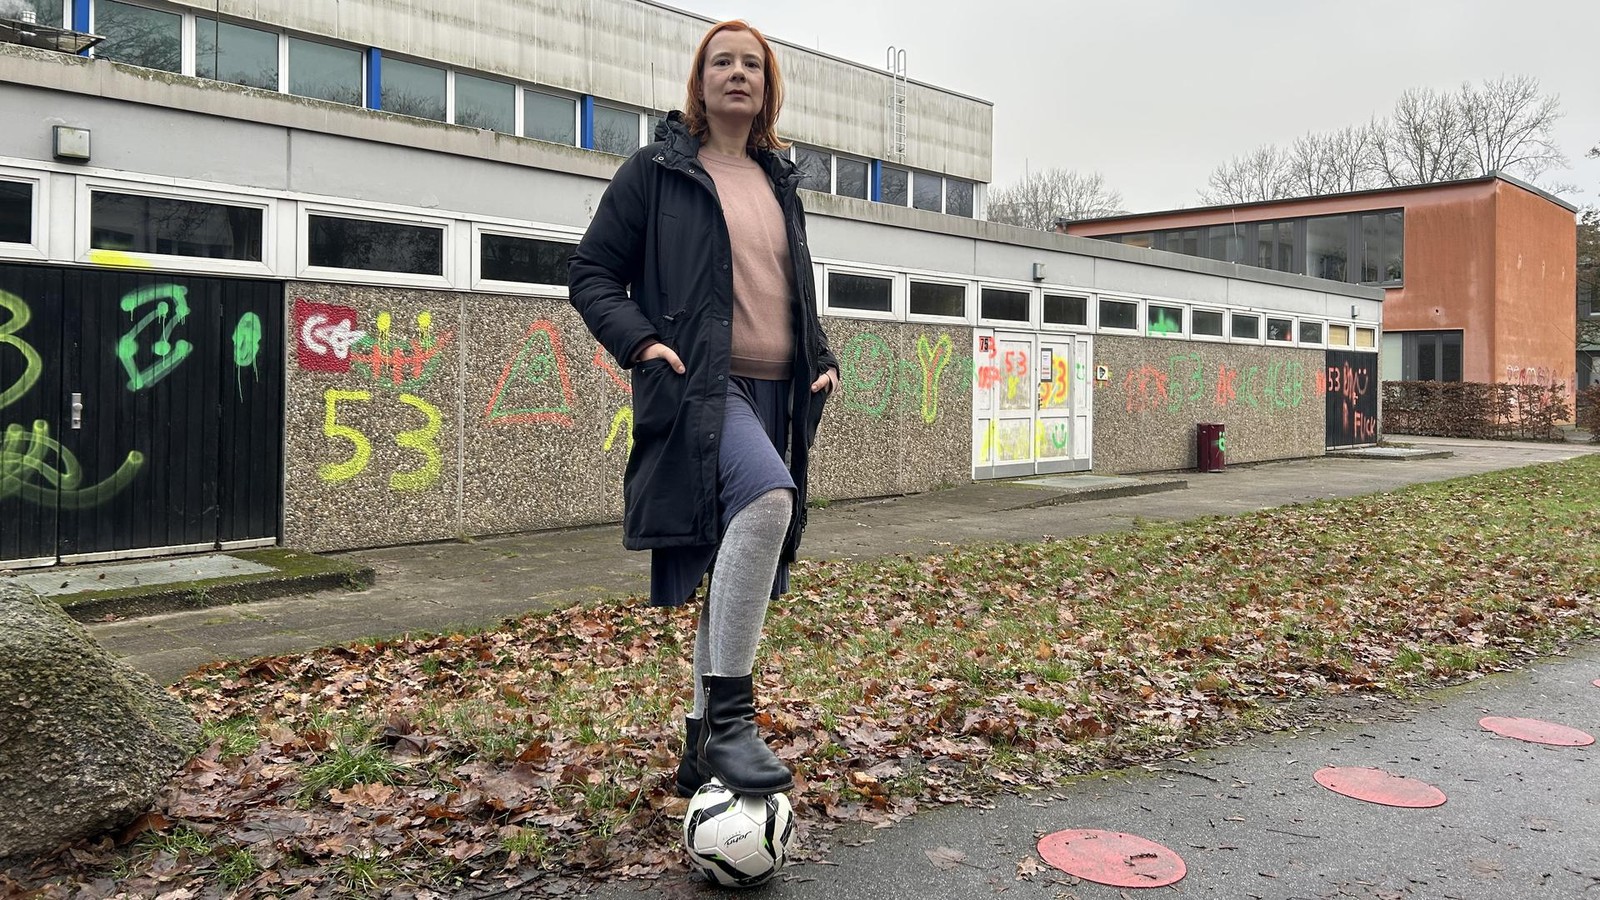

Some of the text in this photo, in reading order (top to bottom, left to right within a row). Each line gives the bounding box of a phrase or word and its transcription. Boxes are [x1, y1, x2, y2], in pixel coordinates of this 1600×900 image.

[1005, 351, 1026, 376] 53
[1328, 367, 1341, 391] 53
[318, 388, 443, 492] 53
